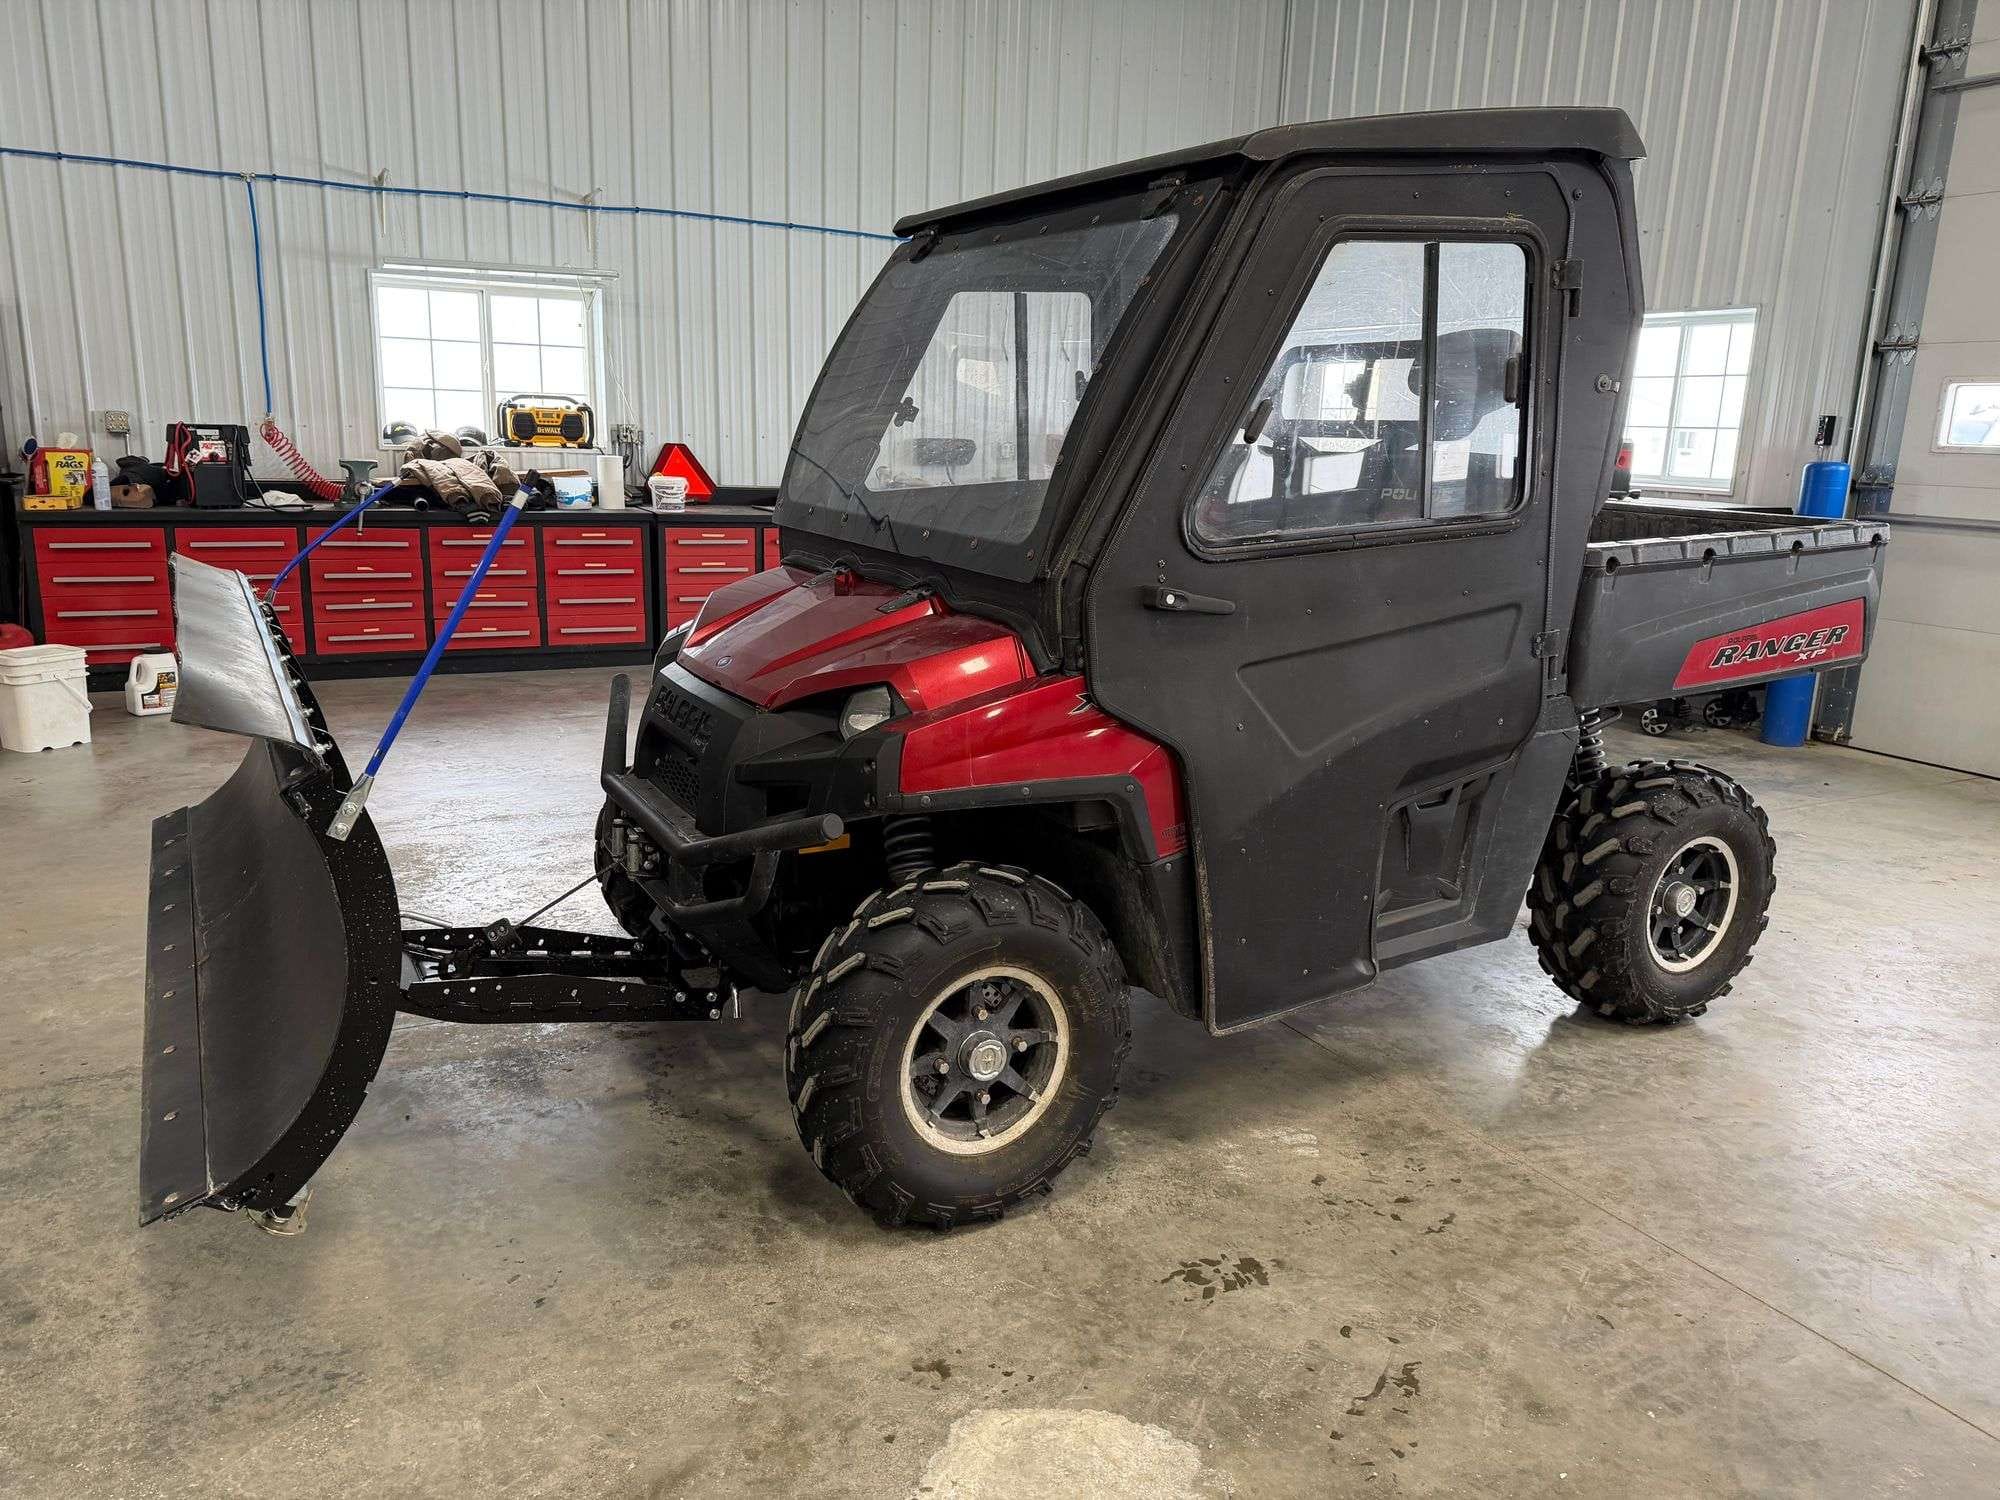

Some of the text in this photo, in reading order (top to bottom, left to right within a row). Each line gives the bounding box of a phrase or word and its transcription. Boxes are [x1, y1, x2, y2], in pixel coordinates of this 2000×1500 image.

[55, 460, 83, 469] RAGS
[1708, 624, 1850, 669] RANGER
[1793, 648, 1828, 664] XP
